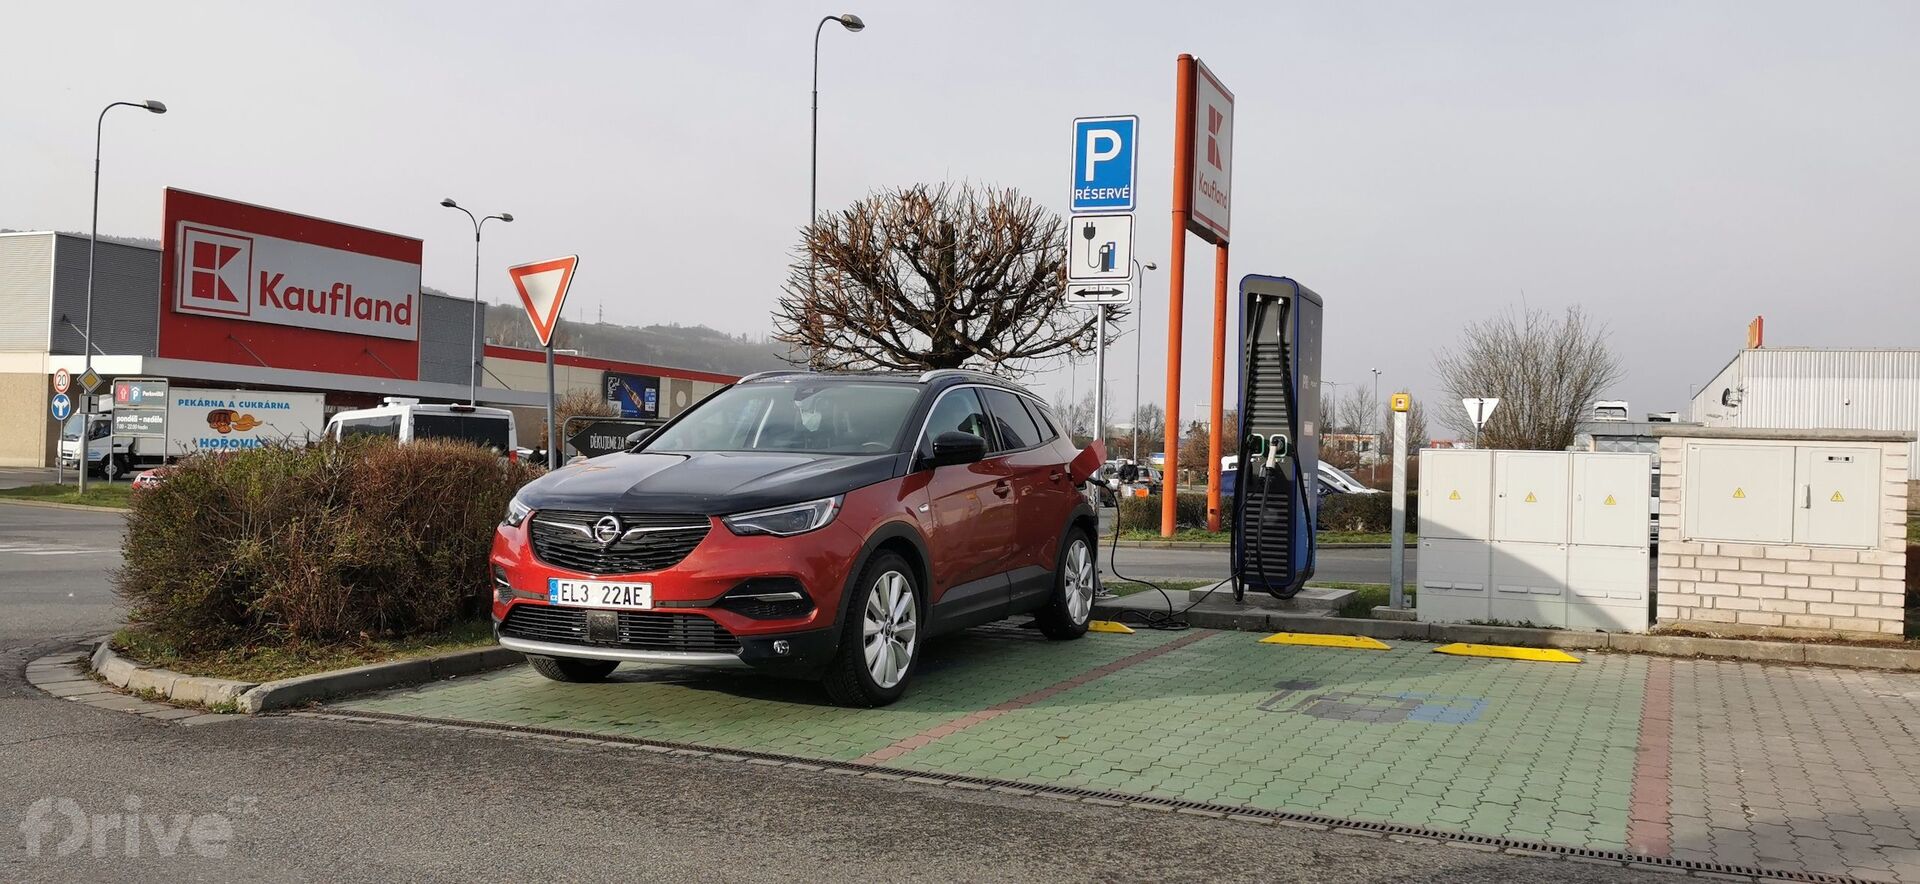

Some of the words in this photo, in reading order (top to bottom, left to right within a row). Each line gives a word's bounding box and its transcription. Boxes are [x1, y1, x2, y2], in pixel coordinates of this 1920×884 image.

[1085, 129, 1122, 182] P
[1075, 185, 1130, 200] RÉSERVÉ
[1199, 170, 1228, 209] Kaufland
[259, 270, 412, 326] Kaufland
[57, 374, 67, 387] 20
[178, 398, 225, 408] PEKÁRNA
[238, 400, 290, 410] CUKRÁRNA
[199, 436, 265, 449] HOŘOVIC
[590, 433, 617, 450] DĚKUJEME
[617, 436, 625, 450] ZA
[561, 583, 589, 603] EL3
[602, 586, 643, 606] 22AE
